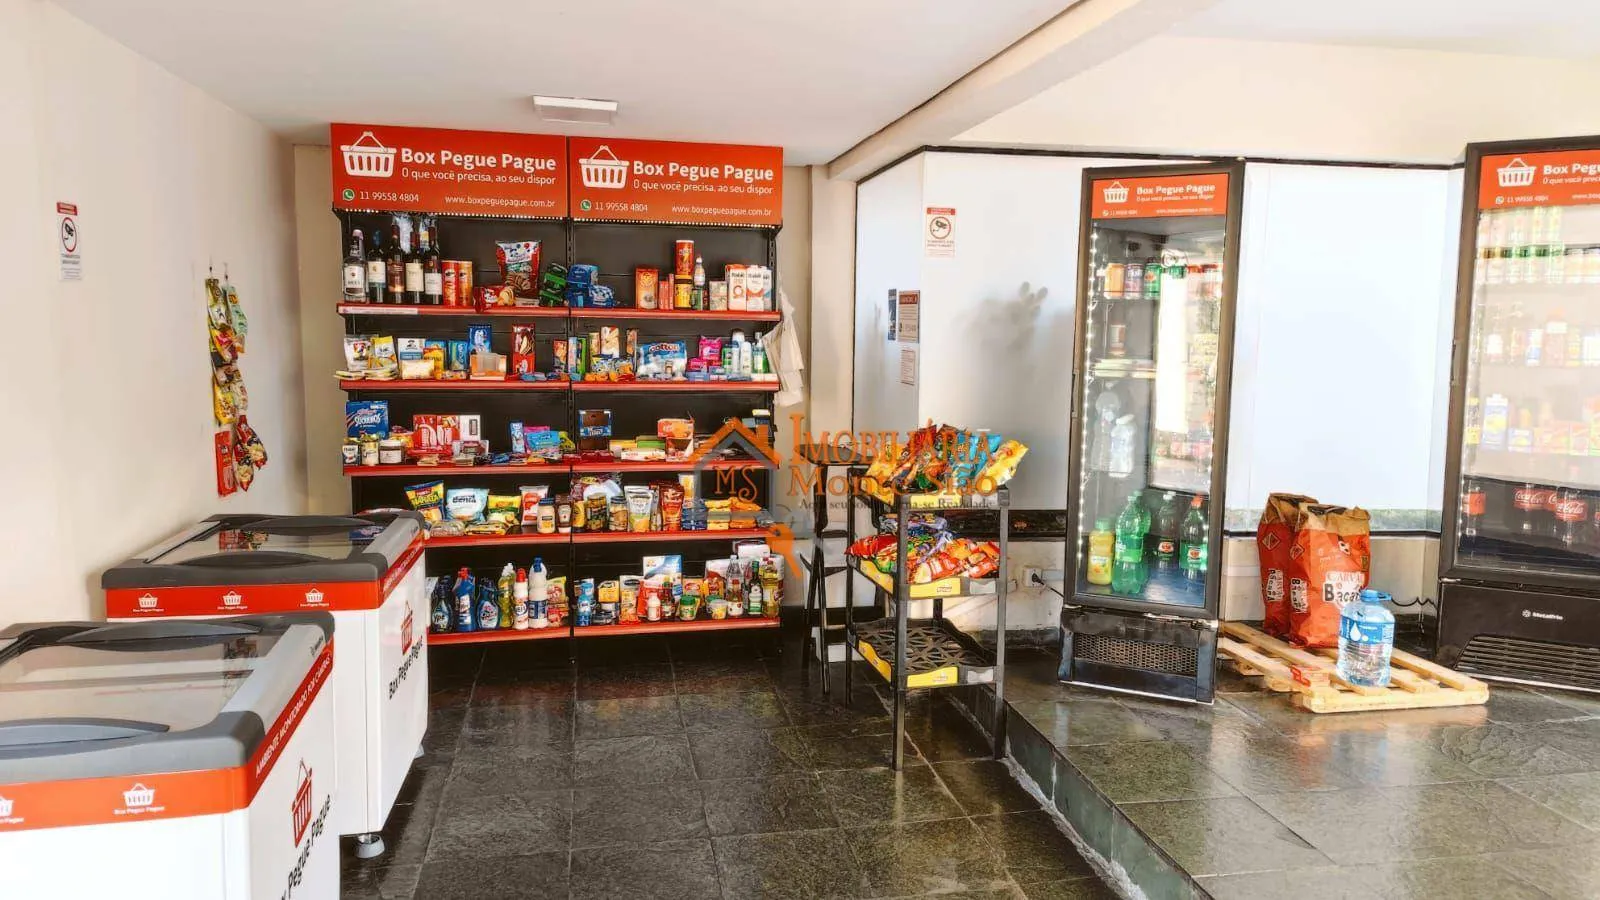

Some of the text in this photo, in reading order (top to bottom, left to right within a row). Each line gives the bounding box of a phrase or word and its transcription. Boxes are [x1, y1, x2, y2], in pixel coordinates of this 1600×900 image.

[401, 147, 557, 173] Box Pegue Pague
[633, 160, 774, 183] Box Pegue Pague
[1543, 164, 1569, 175] Box
[402, 167, 557, 187] O que você precisa, ao seu dispor
[633, 178, 774, 196] O que você precisa, ao seu dispor
[1136, 183, 1216, 196] Box Pegue Pague
[360, 191, 419, 203] 11 99558 4804
[444, 195, 556, 208] www.boxpeguepague.com.br
[595, 202, 648, 213] 11 99558 4804
[671, 205, 773, 217] www.boxpeguepague.com.br
[311, 793, 331, 847] Pague
